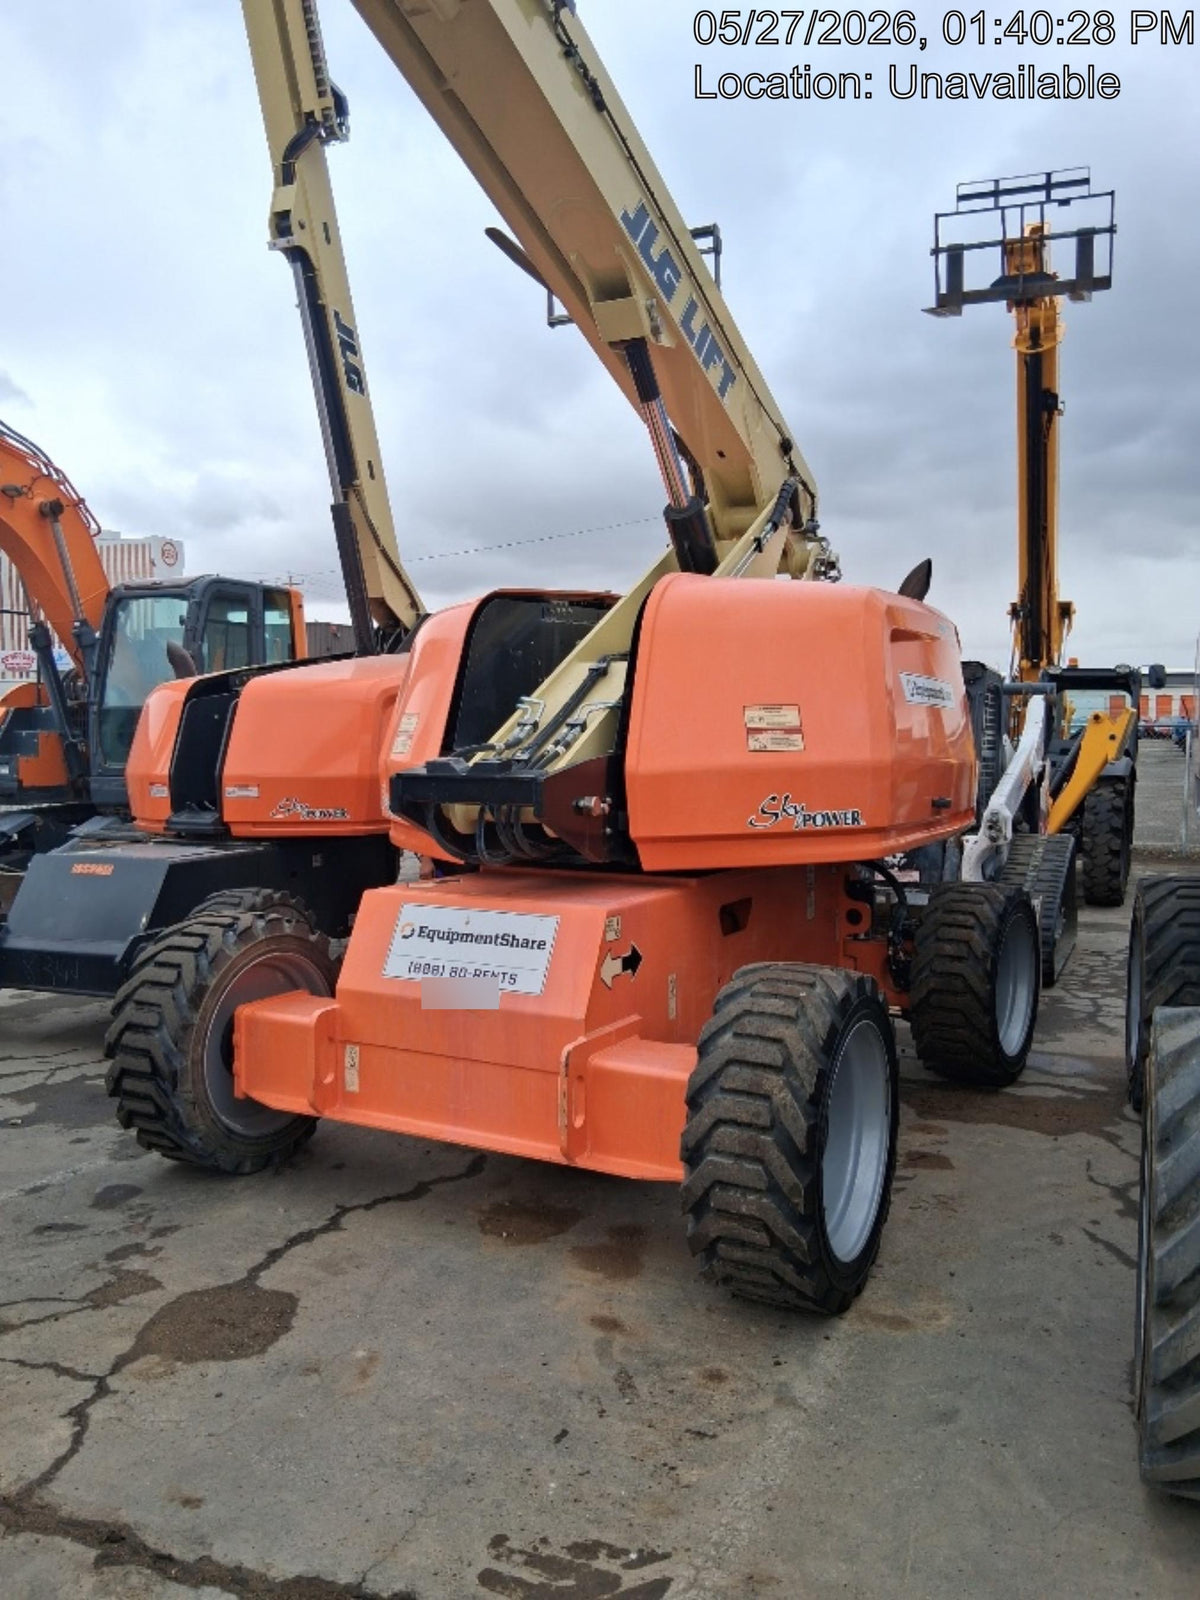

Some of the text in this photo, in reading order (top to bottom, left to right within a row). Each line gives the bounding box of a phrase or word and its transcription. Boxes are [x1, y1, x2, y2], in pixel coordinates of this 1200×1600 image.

[620, 199, 737, 402] JLG LIFT
[747, 793, 865, 829] Sky POWER
[416, 924, 548, 952] EquipmentShare
